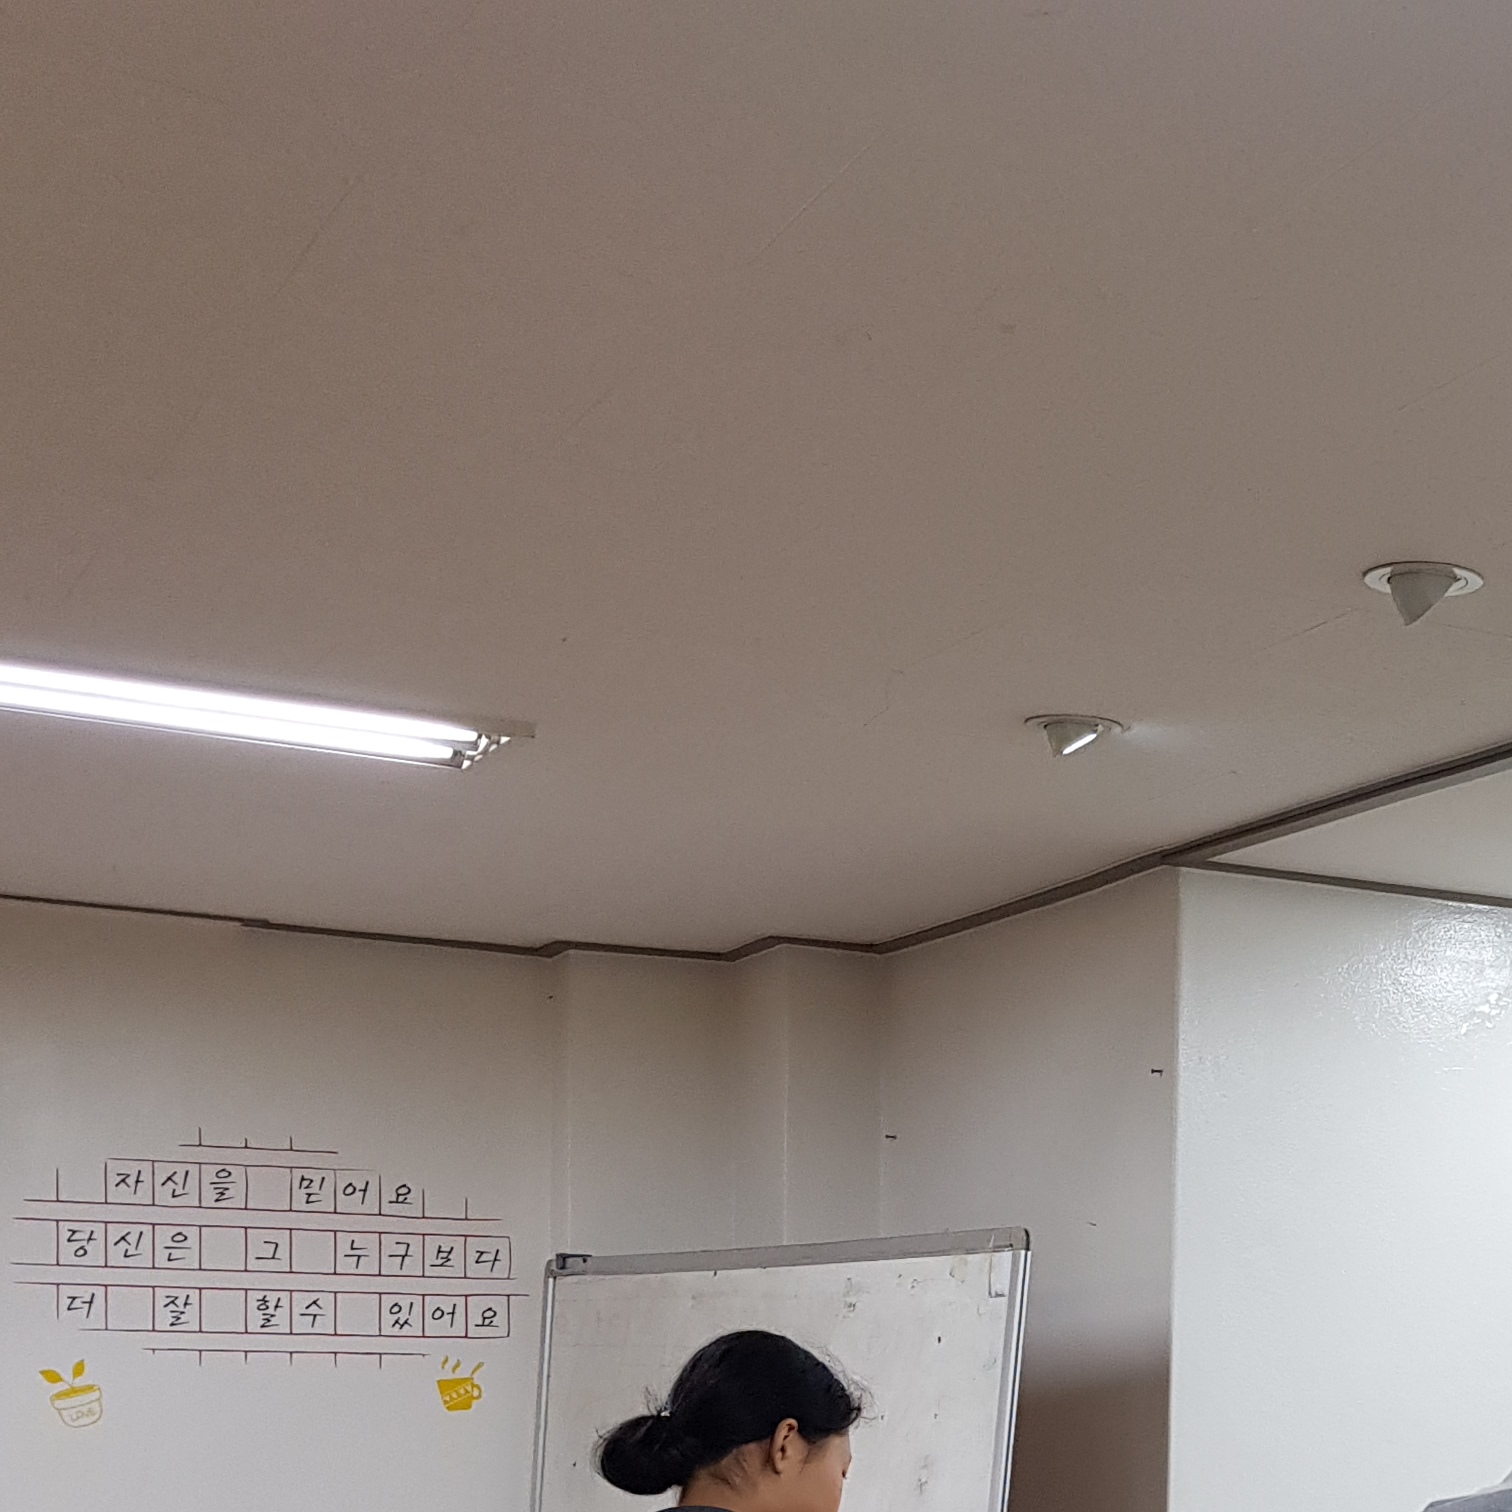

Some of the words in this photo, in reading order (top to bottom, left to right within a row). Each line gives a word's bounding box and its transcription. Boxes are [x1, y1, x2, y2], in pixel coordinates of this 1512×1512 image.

[114, 1167, 237, 1204] 자신을
[298, 1174, 413, 1206] 믿어요
[66, 1228, 193, 1260] 당신은
[255, 1240, 282, 1261] 그
[343, 1238, 501, 1272] 누구보다
[66, 1293, 96, 1319] 더
[162, 1294, 193, 1327] 잘
[388, 1299, 500, 1331] 있어요
